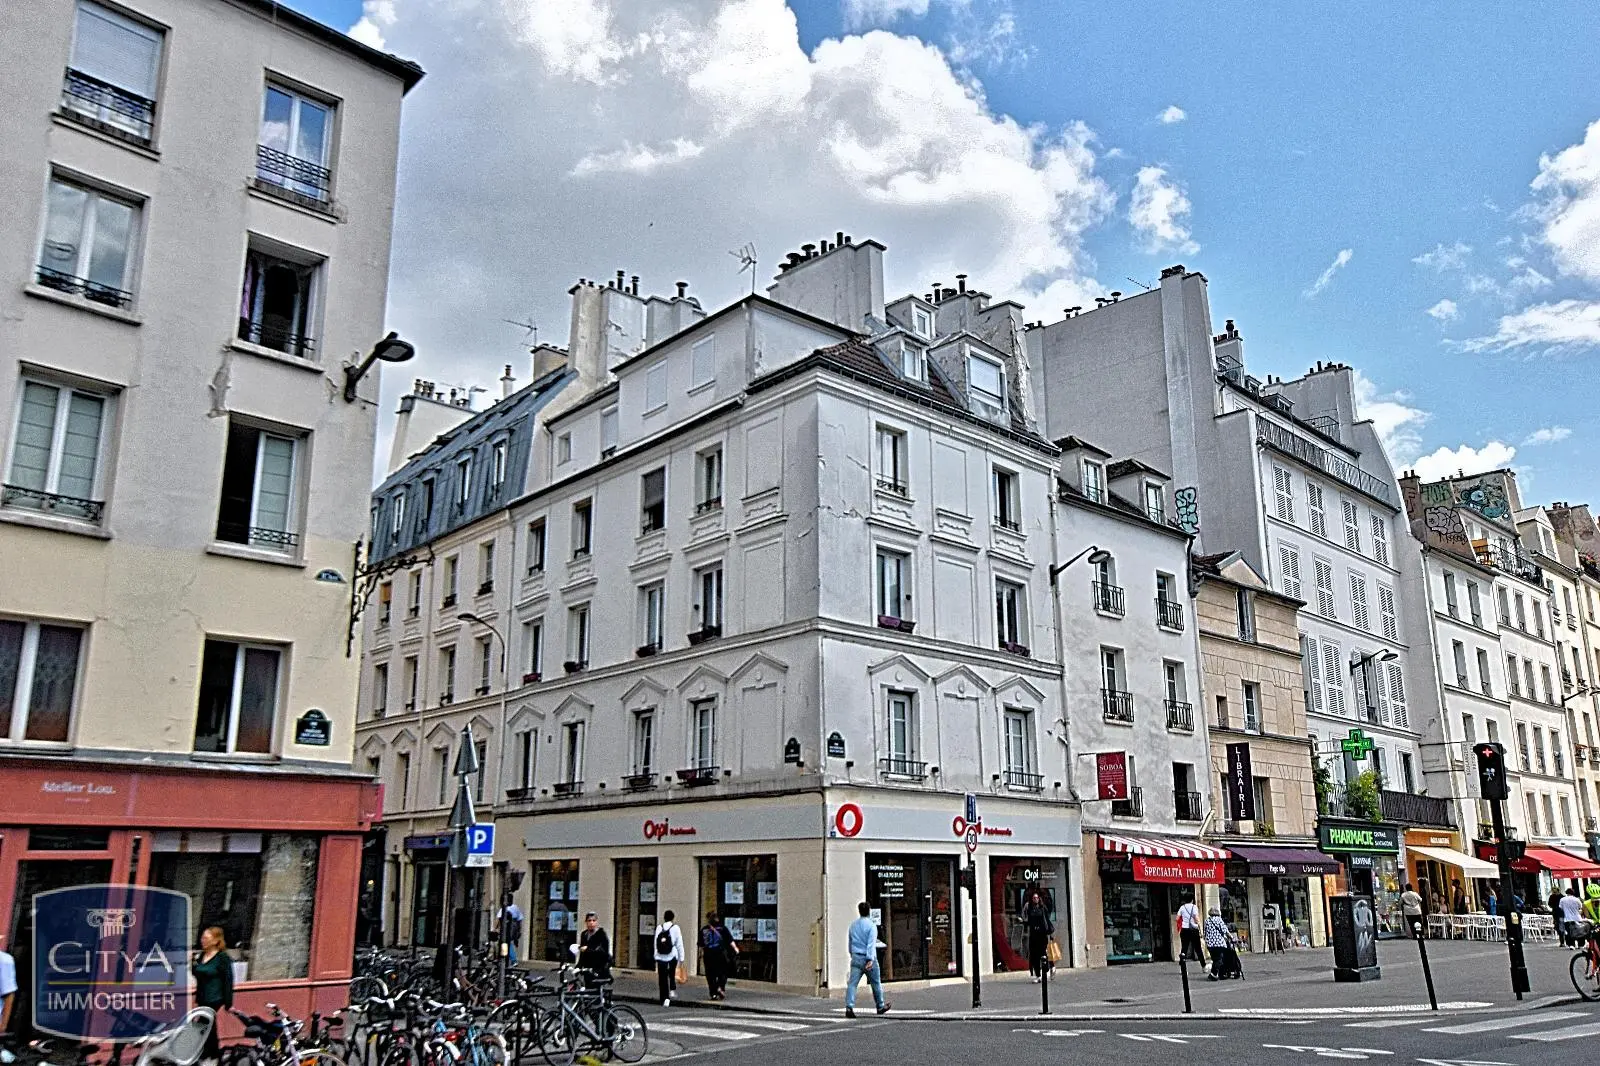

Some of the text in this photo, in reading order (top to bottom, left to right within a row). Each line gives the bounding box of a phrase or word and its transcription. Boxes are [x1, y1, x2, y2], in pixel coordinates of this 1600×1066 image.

[41, 781, 85, 793] Atelier
[1235, 746, 1247, 817] LIBRAIRIE
[643, 817, 668, 841] Orpi
[1329, 828, 1374, 846] PHARMACIE
[473, 829, 487, 850] P
[1024, 868, 1039, 882] Orpi
[1144, 864, 1182, 878] SPECIALITÀ
